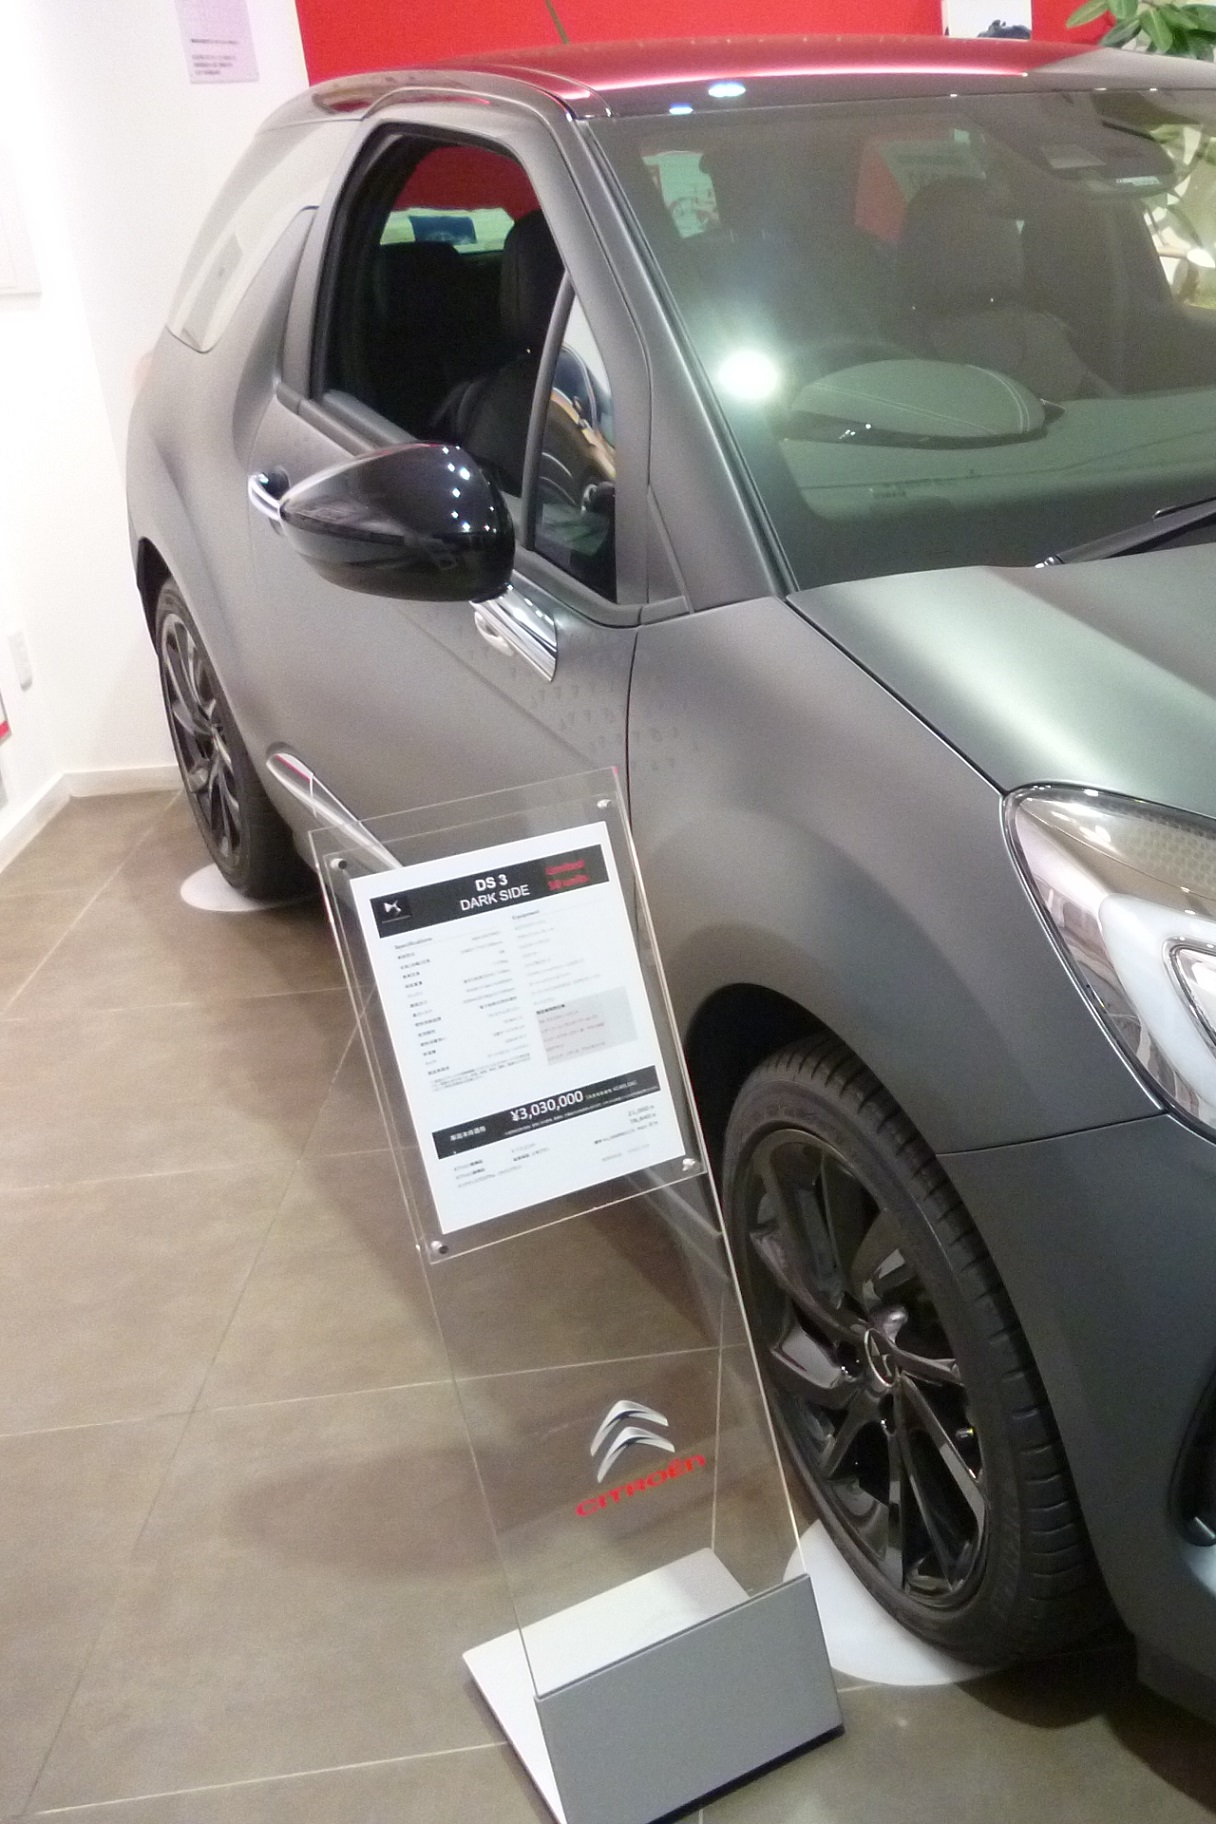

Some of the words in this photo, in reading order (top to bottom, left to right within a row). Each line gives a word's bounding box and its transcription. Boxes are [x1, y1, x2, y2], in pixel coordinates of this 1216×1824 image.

[475, 876, 496, 892] DS
[498, 873, 508, 886] 3
[460, 892, 498, 911] DARK
[499, 884, 530, 901] SIDE
[510, 1090, 584, 1121] ¥3,030,000
